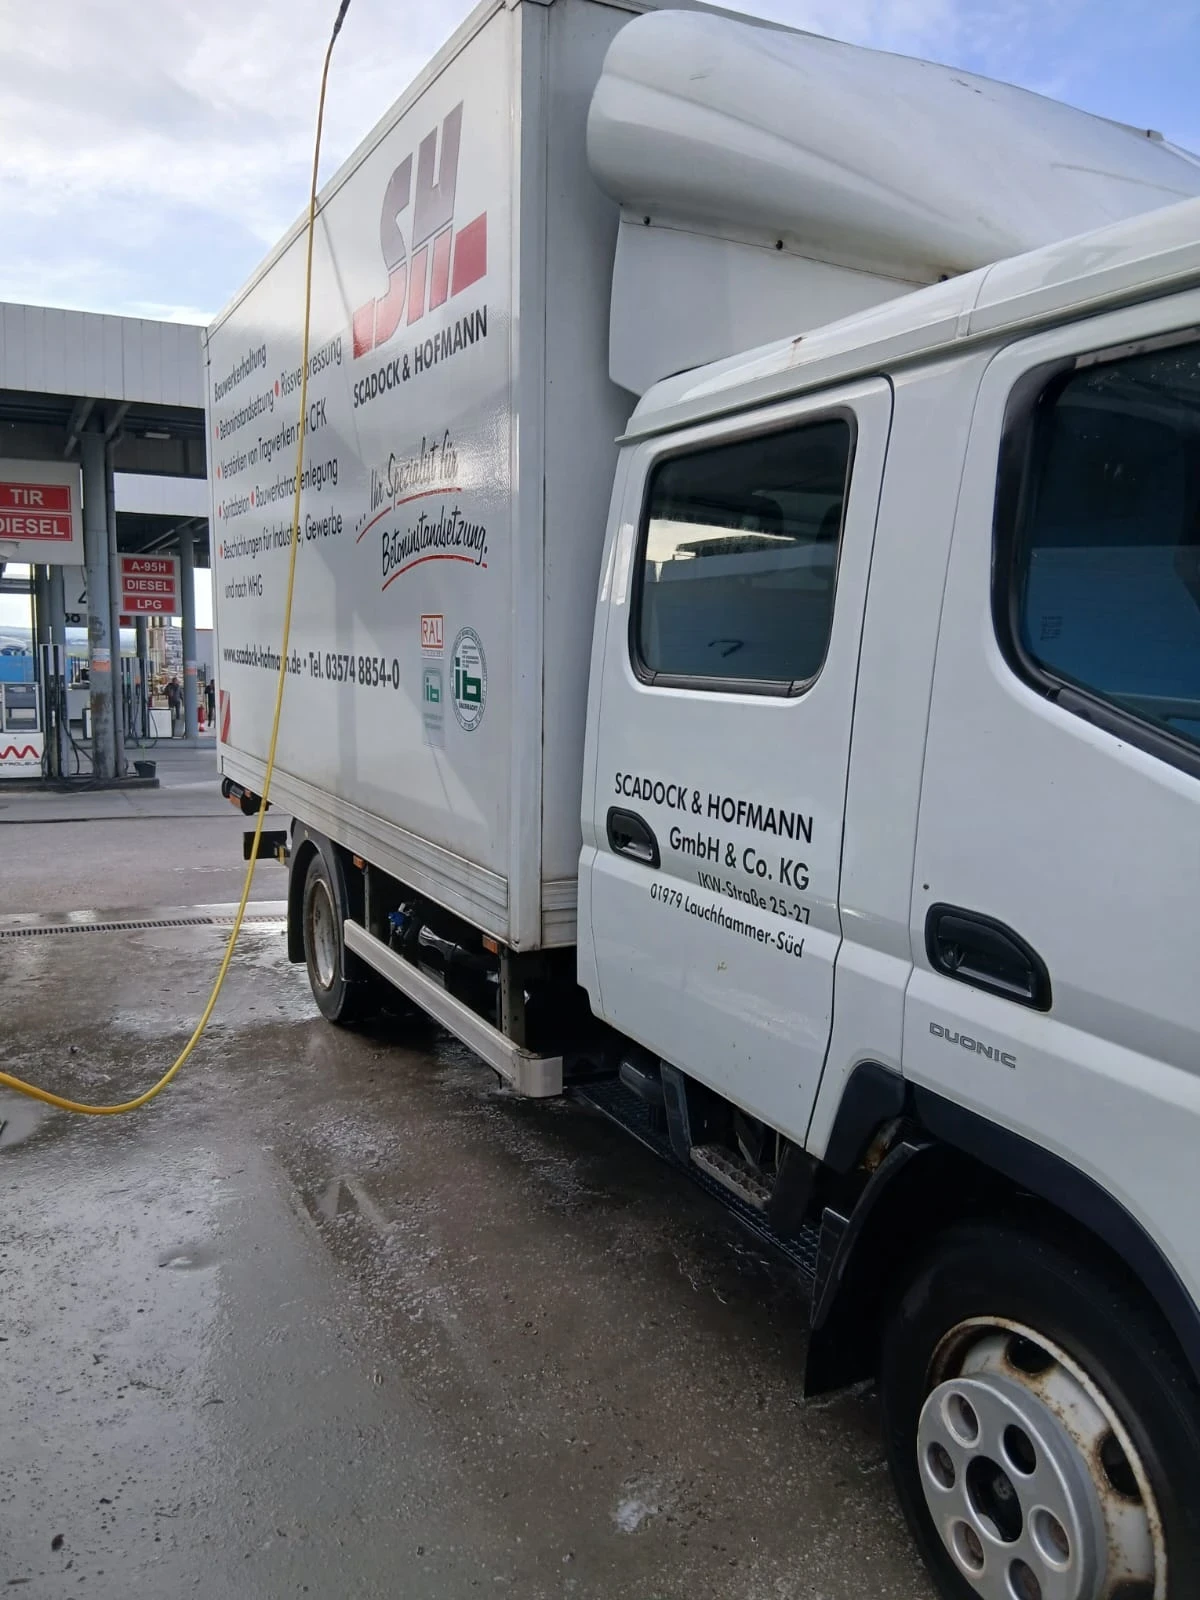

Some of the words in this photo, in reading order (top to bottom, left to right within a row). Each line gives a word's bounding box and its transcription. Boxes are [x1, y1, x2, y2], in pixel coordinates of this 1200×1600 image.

[353, 358, 401, 409] SCADOCK
[402, 353, 411, 382] &
[414, 304, 487, 375] HOFMANN
[259, 421, 296, 462] Tragwerken
[310, 397, 327, 432] CFK
[10, 488, 44, 506] TIR
[263, 526, 273, 552] für
[305, 506, 343, 541] Gewerbe
[382, 505, 488, 577] Betoninstandsetzung.
[126, 579, 171, 592] DIESEL
[131, 560, 167, 573] A-95H
[247, 573, 263, 597] WHG
[136, 599, 163, 610] LPG
[422, 620, 442, 645] RAL
[308, 651, 324, 679] Tel.
[325, 653, 356, 683] 03574
[358, 657, 400, 690] 8854-0
[614, 772, 688, 811] SCADOCK
[691, 789, 702, 815] &
[707, 793, 814, 844] HOFMANN
[669, 826, 720, 863] GmbH
[724, 842, 737, 869] &
[742, 848, 773, 880] Co.
[779, 857, 810, 891] KG
[650, 883, 683, 908] 01979
[684, 895, 805, 958] Lauchhammer-Süd
[769, 896, 811, 925] 25-27
[929, 1022, 1017, 1069] DUONIC
